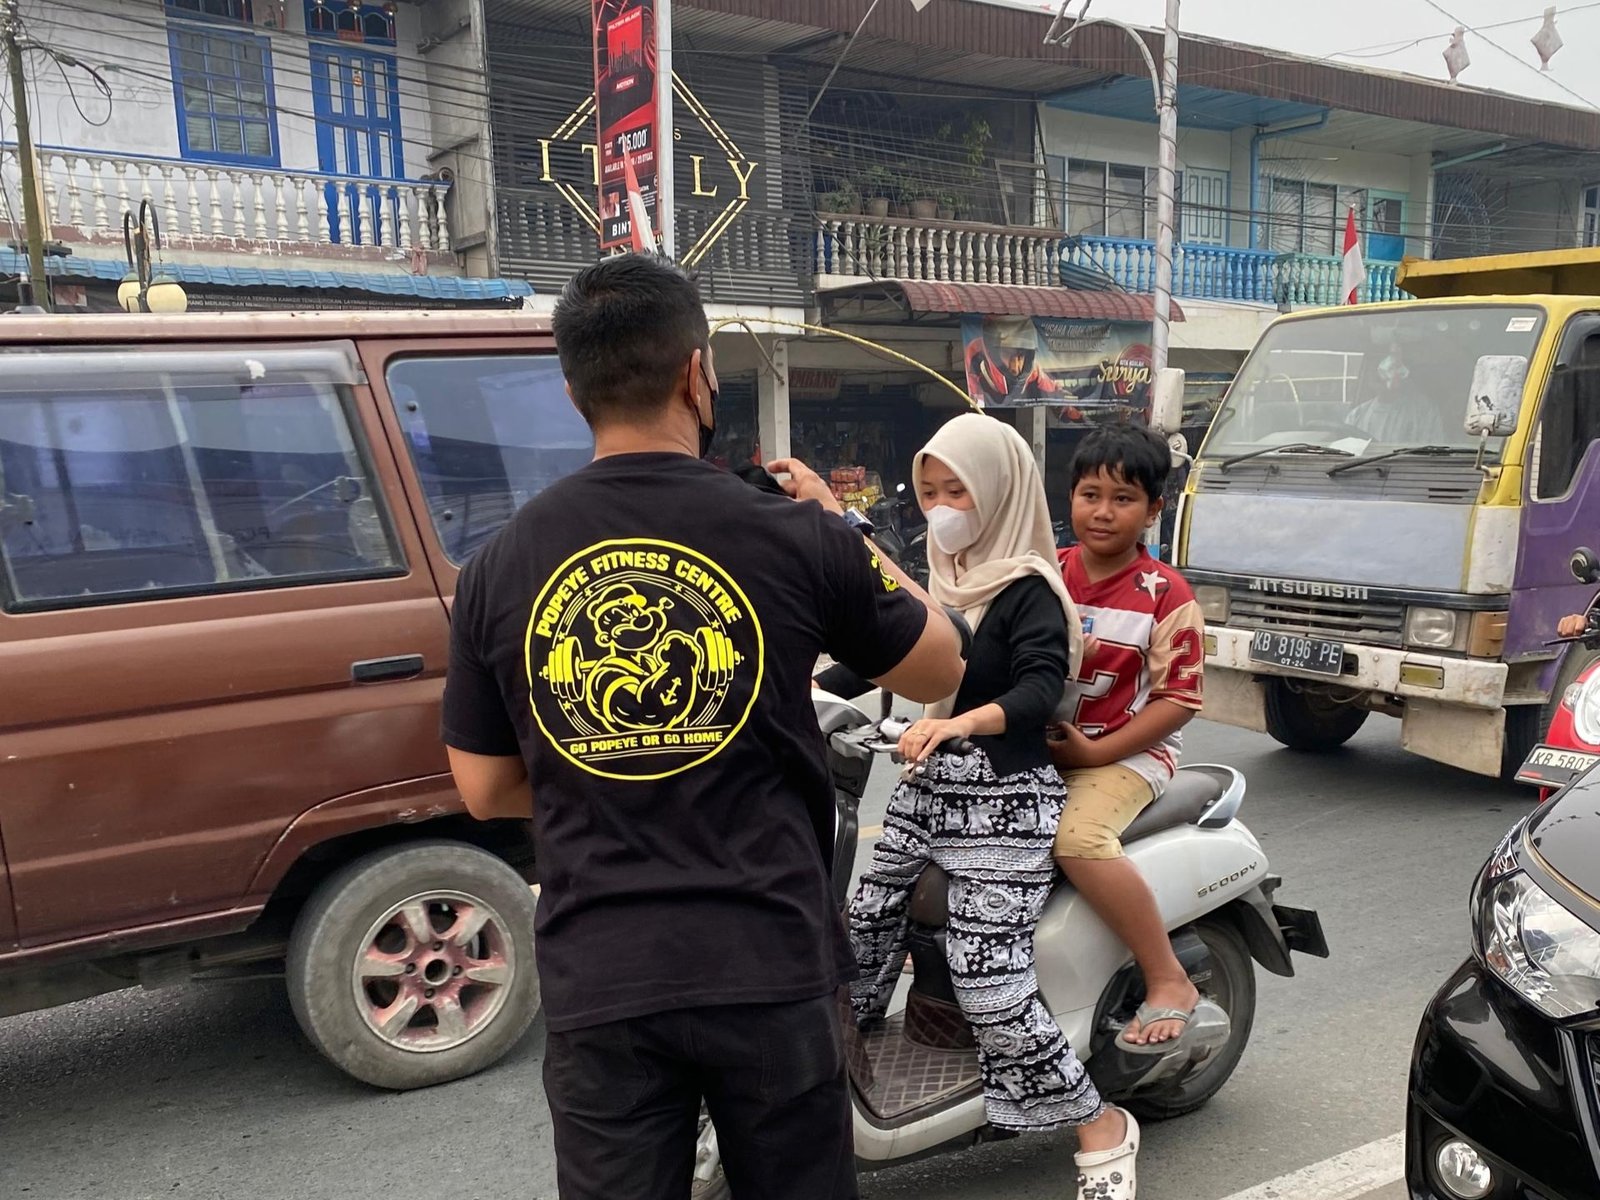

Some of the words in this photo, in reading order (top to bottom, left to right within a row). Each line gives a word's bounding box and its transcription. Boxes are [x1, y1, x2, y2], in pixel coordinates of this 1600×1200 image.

[1098, 360, 1152, 391] Surya
[535, 566, 590, 639] POPEYE
[590, 551, 671, 575] FITNESS
[674, 559, 742, 624] CENTRE
[1249, 578, 1368, 600] MITSUBISHI
[1167, 627, 1203, 692] 2
[1254, 631, 1271, 652] KB
[1278, 636, 1312, 659] 8196
[1319, 642, 1341, 664] PE
[570, 743, 587, 754] GO
[591, 738, 638, 752] POPEYE
[642, 735, 660, 745] OR
[664, 734, 680, 744] GO
[686, 731, 723, 743] HOME
[1534, 752, 1553, 765] KB
[1196, 862, 1257, 898] SCOOPY
